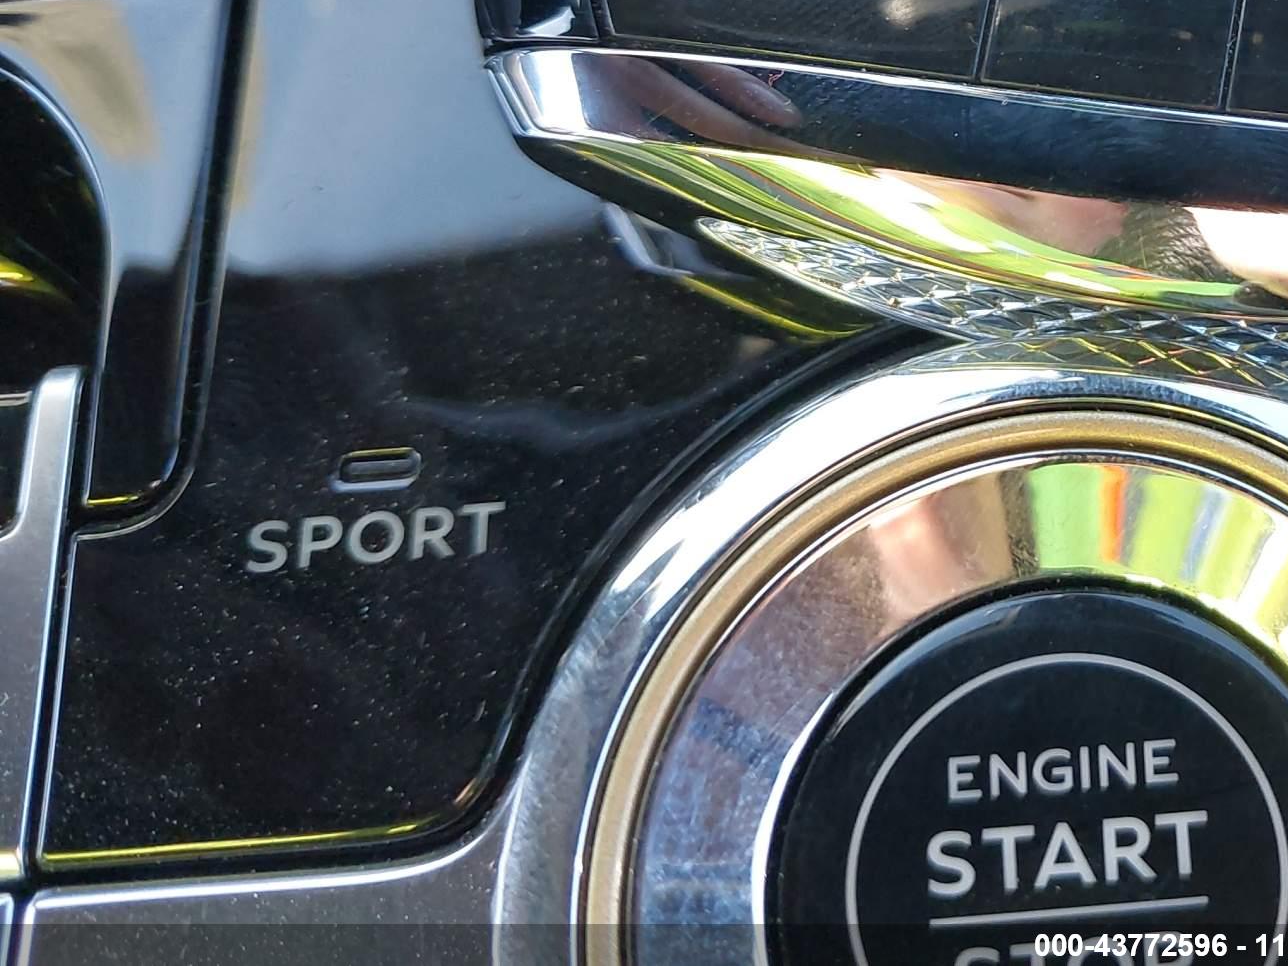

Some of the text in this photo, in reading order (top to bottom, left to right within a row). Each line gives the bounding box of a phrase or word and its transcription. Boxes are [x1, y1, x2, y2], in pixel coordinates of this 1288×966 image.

[246, 501, 506, 573] SPORT
[947, 738, 1179, 804] ENGINE
[925, 810, 1208, 899] START
